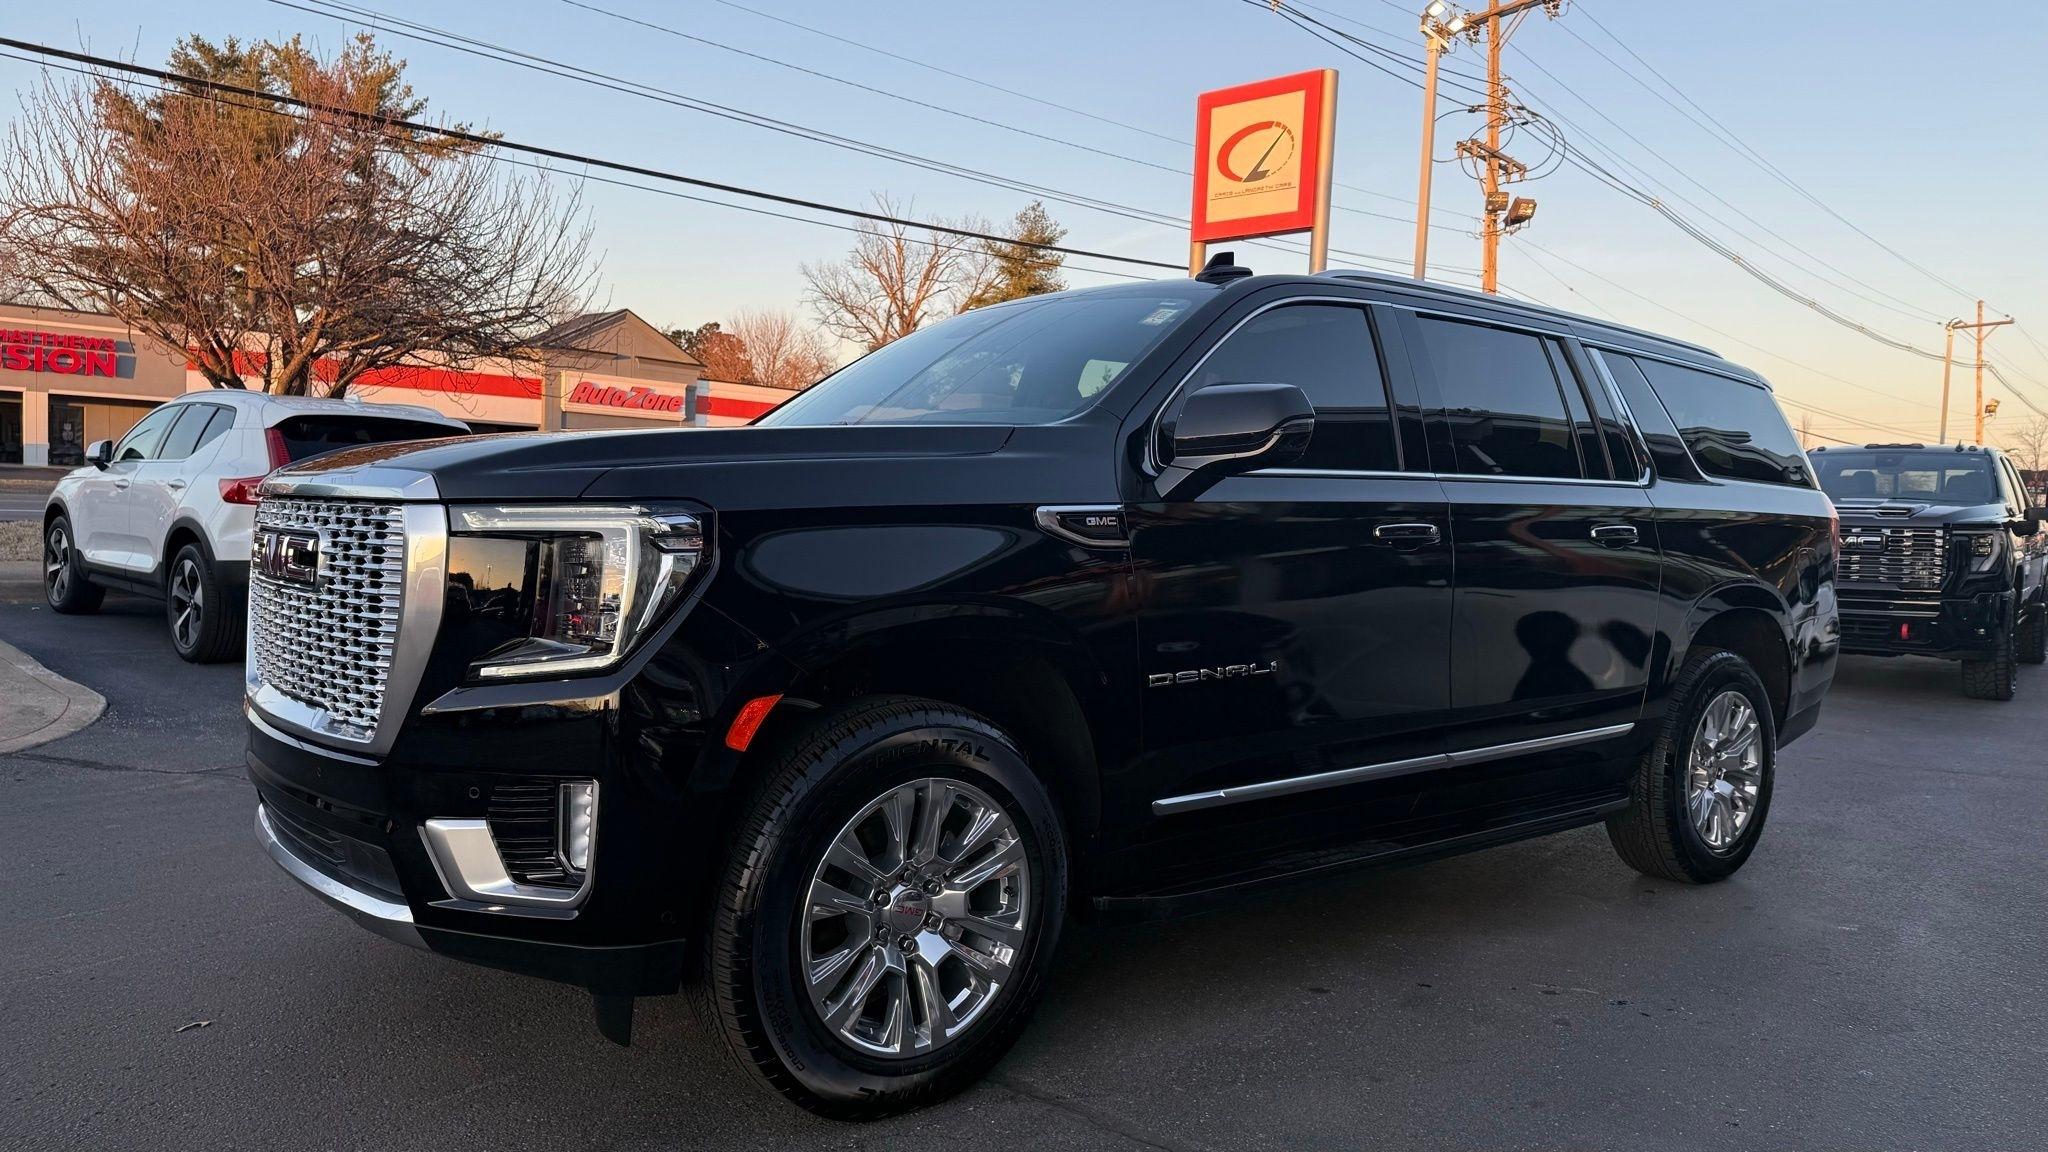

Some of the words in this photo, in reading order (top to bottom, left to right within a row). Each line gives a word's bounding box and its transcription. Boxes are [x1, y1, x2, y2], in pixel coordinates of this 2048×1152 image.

[0, 342, 117, 378] SION
[568, 381, 685, 412] AutoZone
[1086, 516, 1117, 526] GMC
[1149, 660, 1278, 687] DENALI
